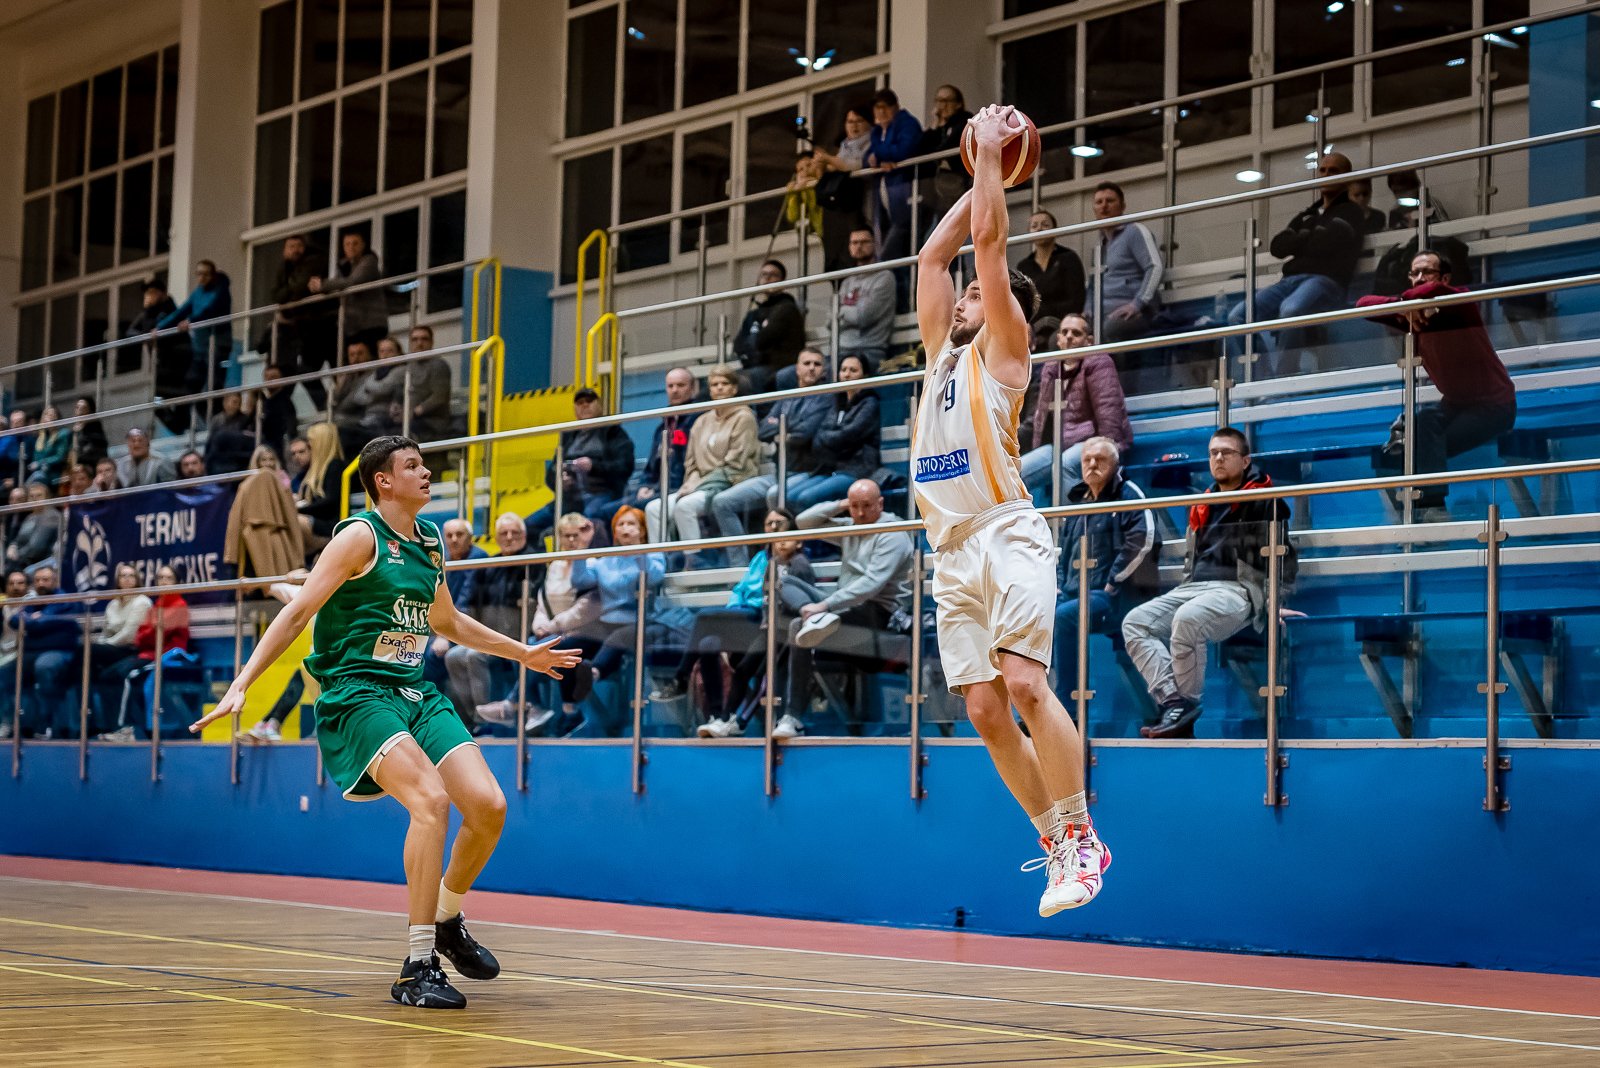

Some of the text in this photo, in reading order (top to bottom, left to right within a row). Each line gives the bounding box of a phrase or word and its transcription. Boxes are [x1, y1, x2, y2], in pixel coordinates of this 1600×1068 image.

[944, 378, 956, 413] 9
[135, 508, 197, 548] TERMY
[380, 635, 409, 649] Exact
[398, 648, 424, 660] Syste
